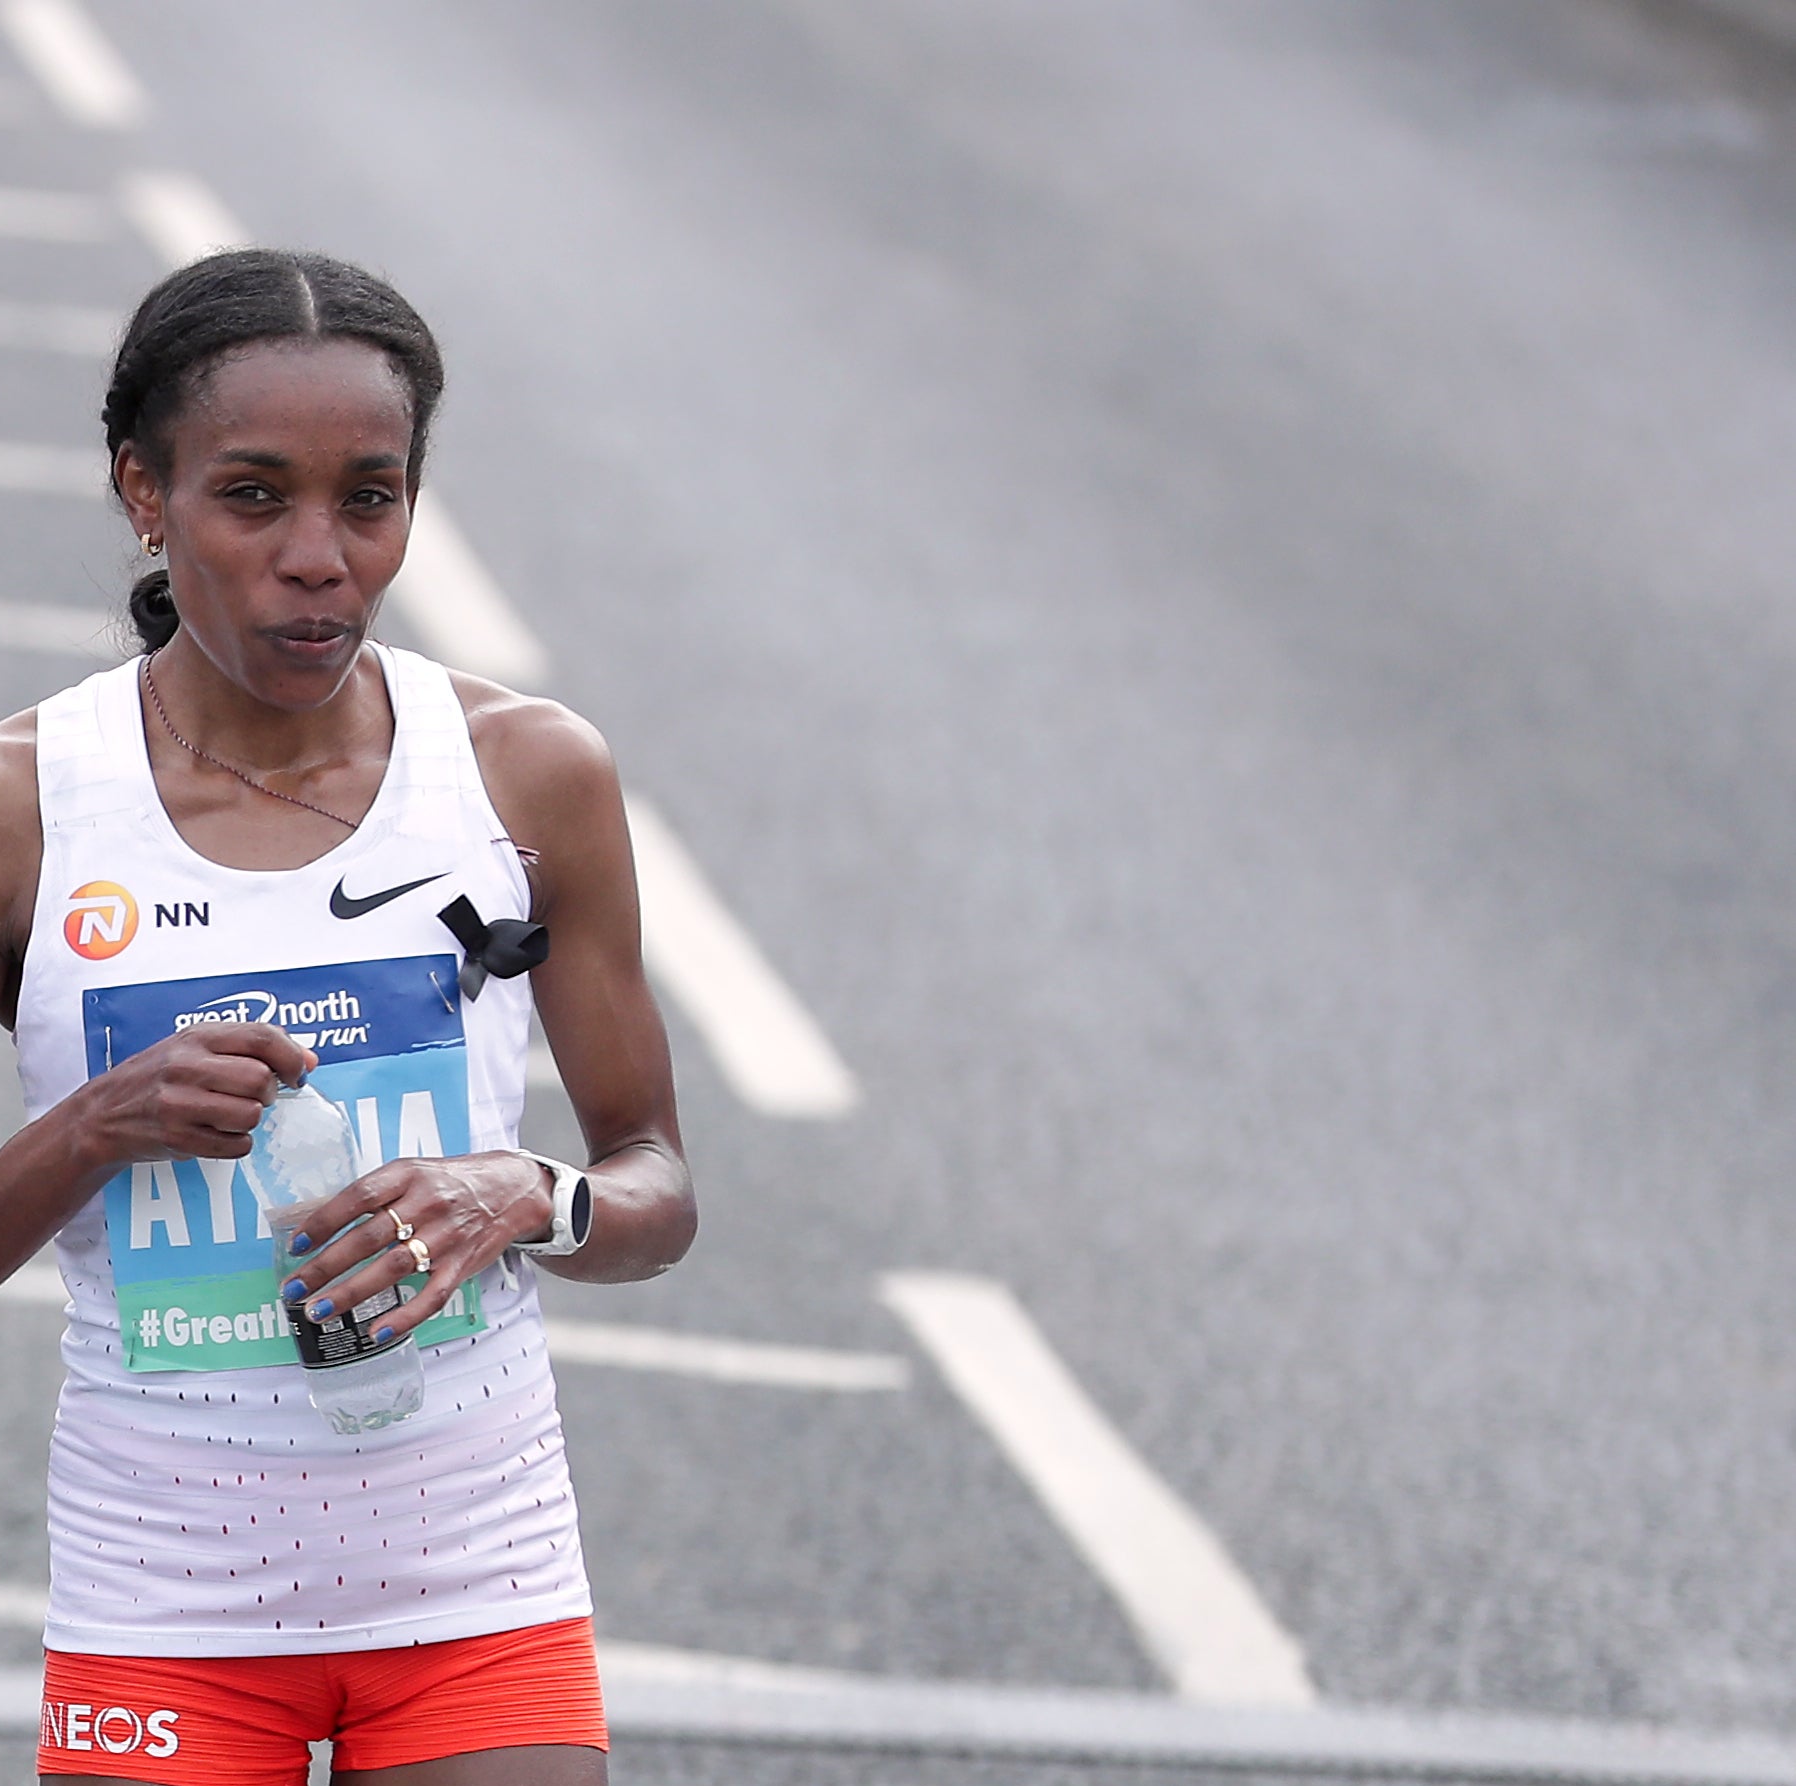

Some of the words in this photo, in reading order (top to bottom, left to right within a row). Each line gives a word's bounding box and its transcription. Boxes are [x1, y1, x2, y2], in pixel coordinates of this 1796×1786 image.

[154, 902, 209, 928] NN
[278, 990, 360, 1026] north
[318, 1026, 368, 1048] run
